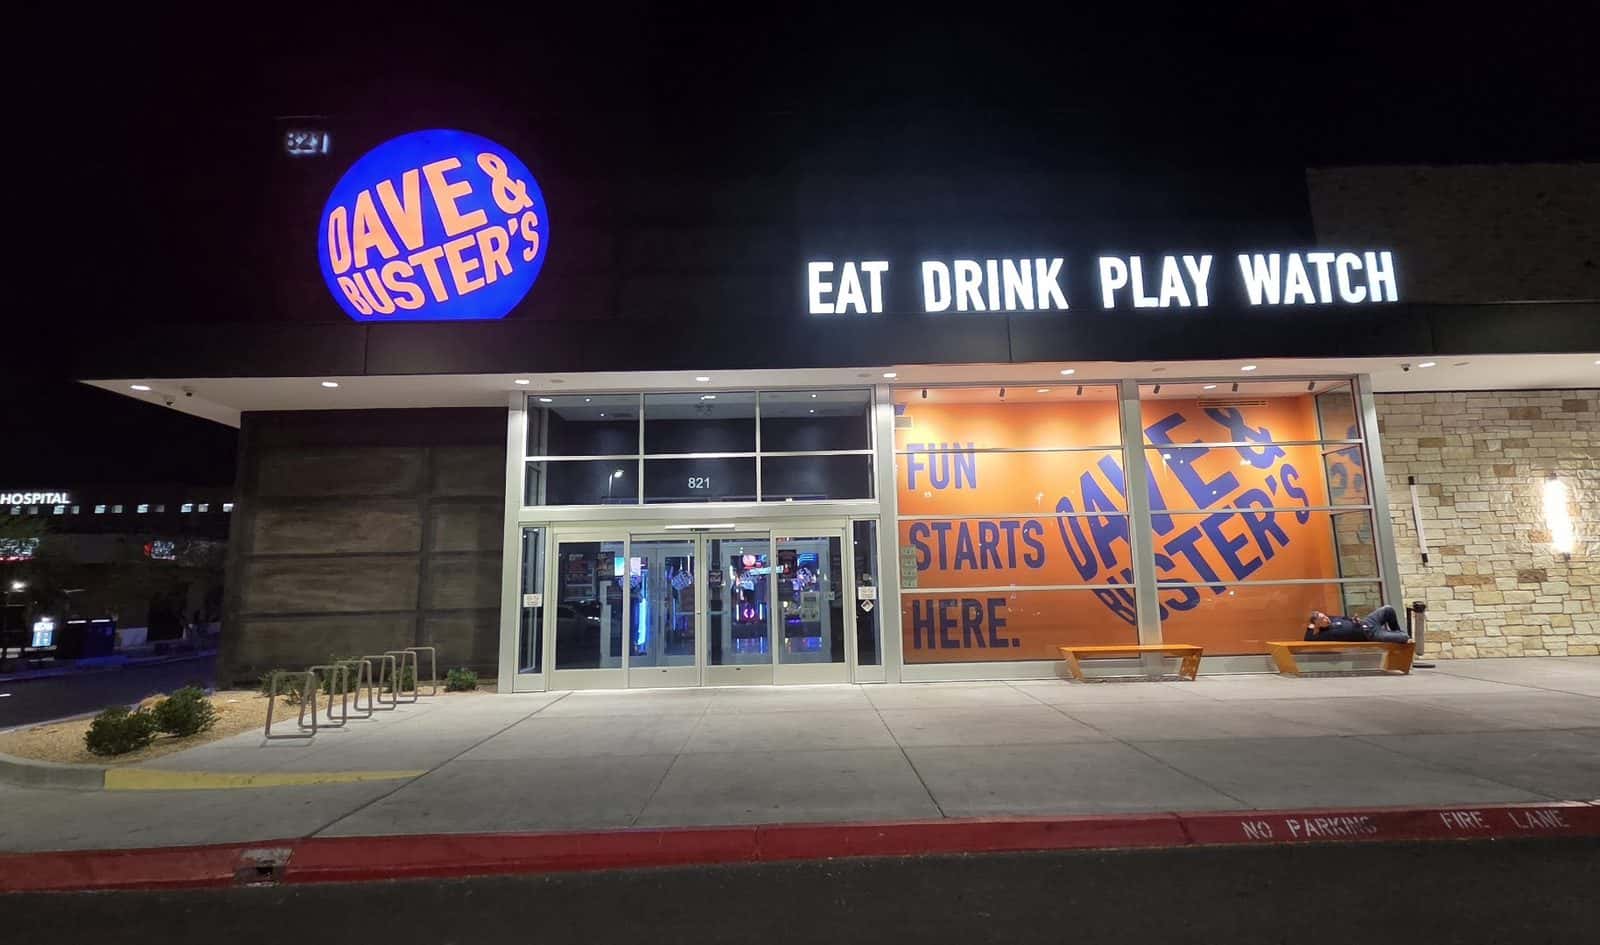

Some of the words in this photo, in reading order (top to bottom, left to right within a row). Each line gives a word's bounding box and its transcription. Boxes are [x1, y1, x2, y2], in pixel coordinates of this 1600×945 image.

[327, 156, 488, 275] DAVE
[476, 152, 534, 214] &
[336, 210, 540, 316] BUSTER'S
[808, 260, 889, 315] EAT
[921, 257, 1069, 313] DRINK
[1098, 254, 1213, 309] PLAY
[1237, 251, 1398, 306] WATCH
[1204, 407, 1286, 469] &
[687, 477, 710, 489] 821
[907, 442, 977, 490] FUN
[0, 492, 71, 505] HOSPITAL
[909, 519, 1045, 571] STARTS
[913, 598, 1020, 649] HERE.
[1241, 821, 1273, 839] NO
[1285, 816, 1377, 838] PARKING
[1440, 811, 1490, 830] FIRE
[1508, 809, 1570, 829] LANE
